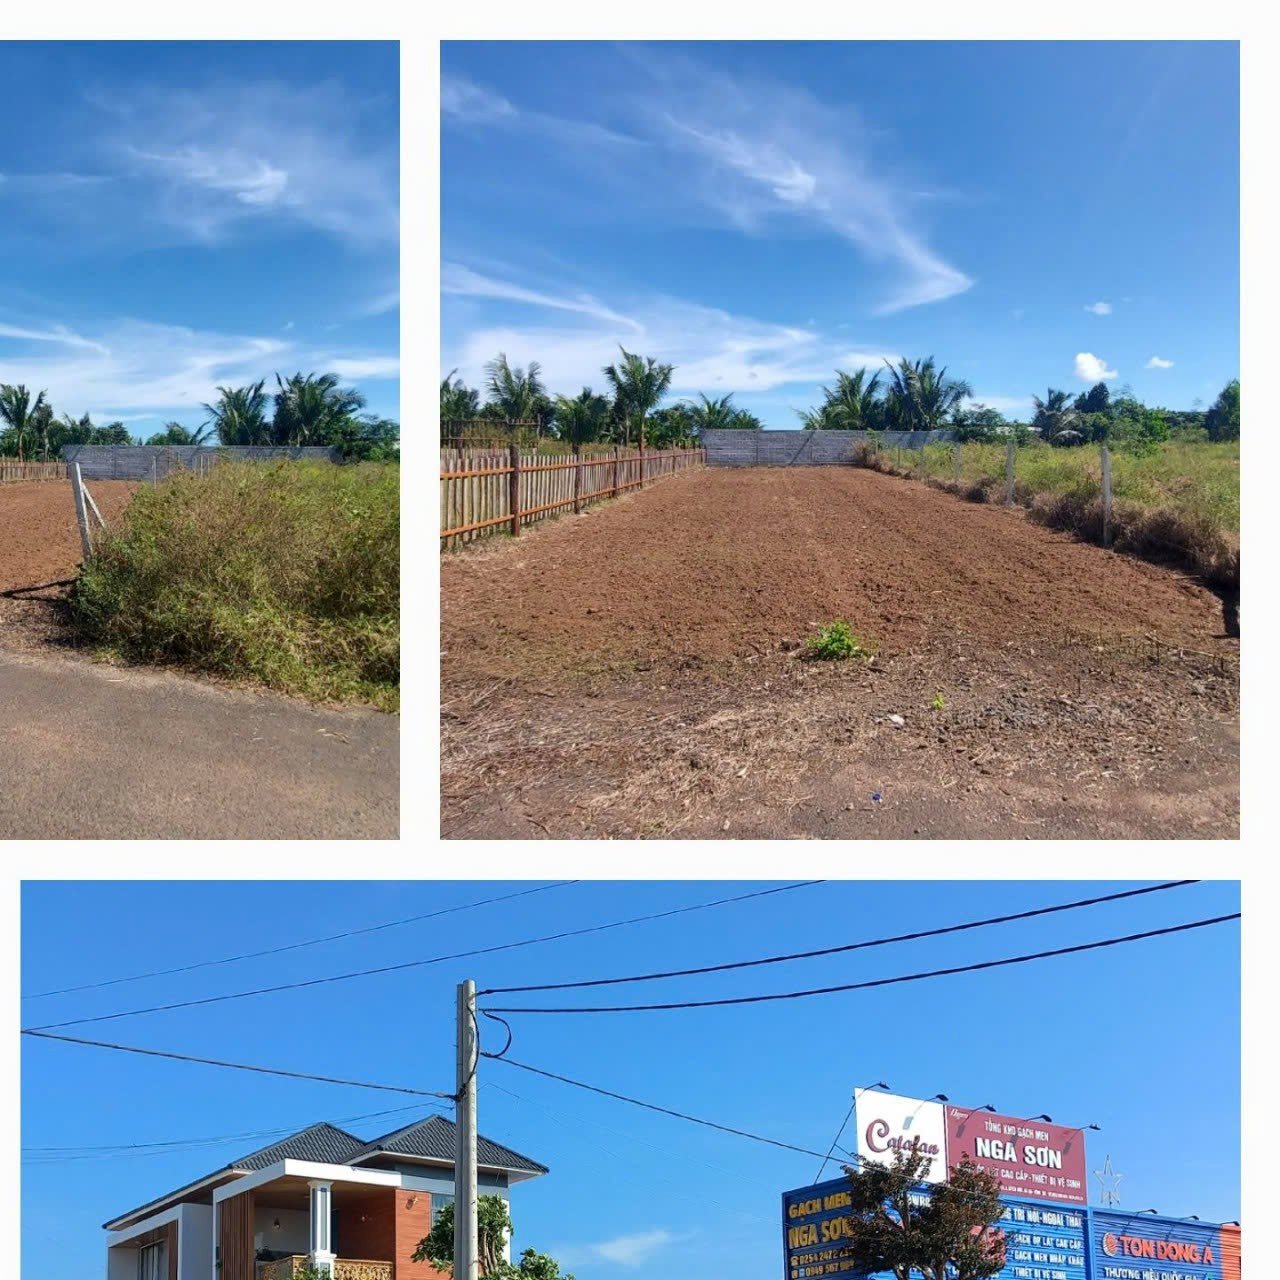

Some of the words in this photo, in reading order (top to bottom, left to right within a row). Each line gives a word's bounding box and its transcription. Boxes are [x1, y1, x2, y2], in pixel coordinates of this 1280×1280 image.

[1004, 1125, 1016, 1136] KHO
[1035, 1131, 1049, 1141] MEN
[976, 1137, 1017, 1163] NGA
[1023, 1145, 1062, 1169] SƠN
[789, 1224, 819, 1249] NGA
